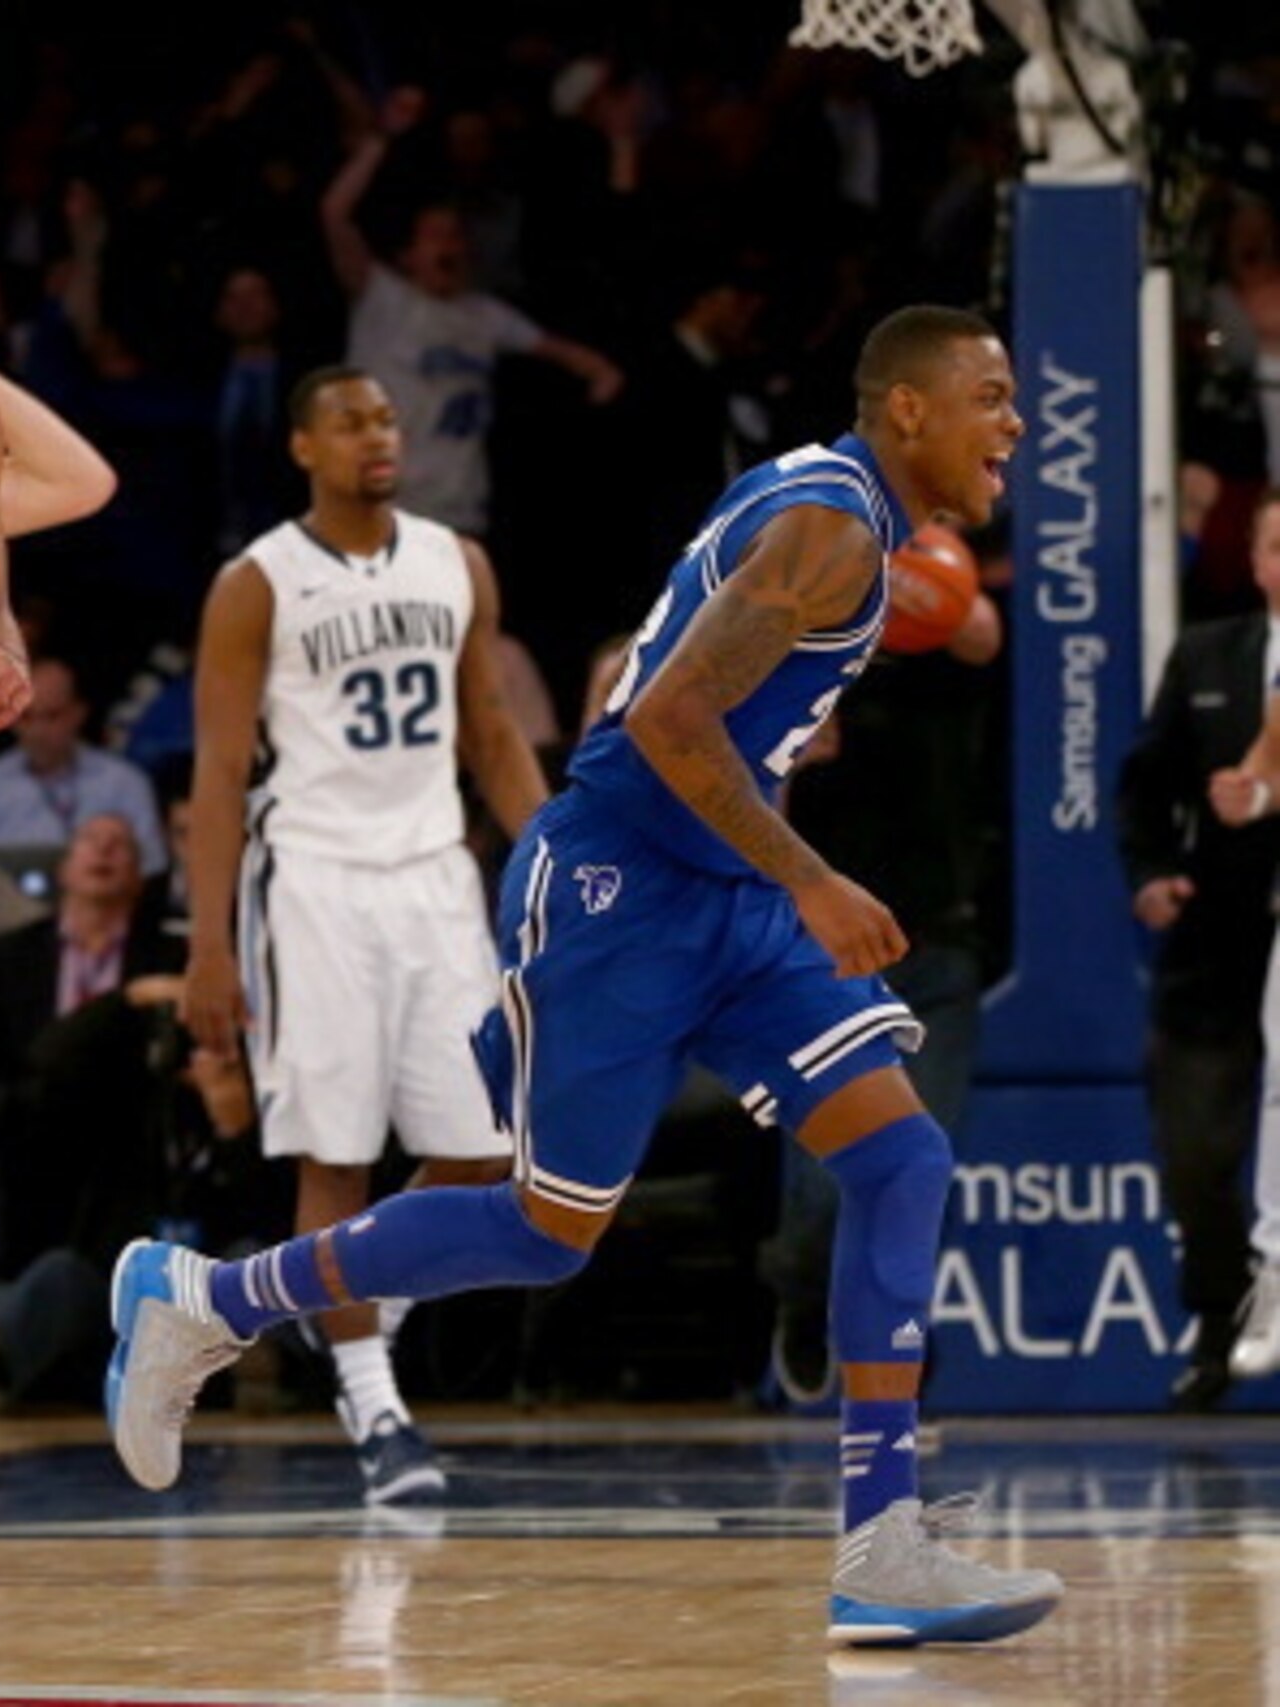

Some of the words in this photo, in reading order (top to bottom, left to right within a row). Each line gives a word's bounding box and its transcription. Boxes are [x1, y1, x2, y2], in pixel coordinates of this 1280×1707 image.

[1037, 352, 1097, 621] GALAXY
[342, 661, 440, 749] 32
[1051, 635, 1107, 831] Samsung
[951, 1162, 1180, 1252] msun
[931, 1247, 1200, 1357] ALA
